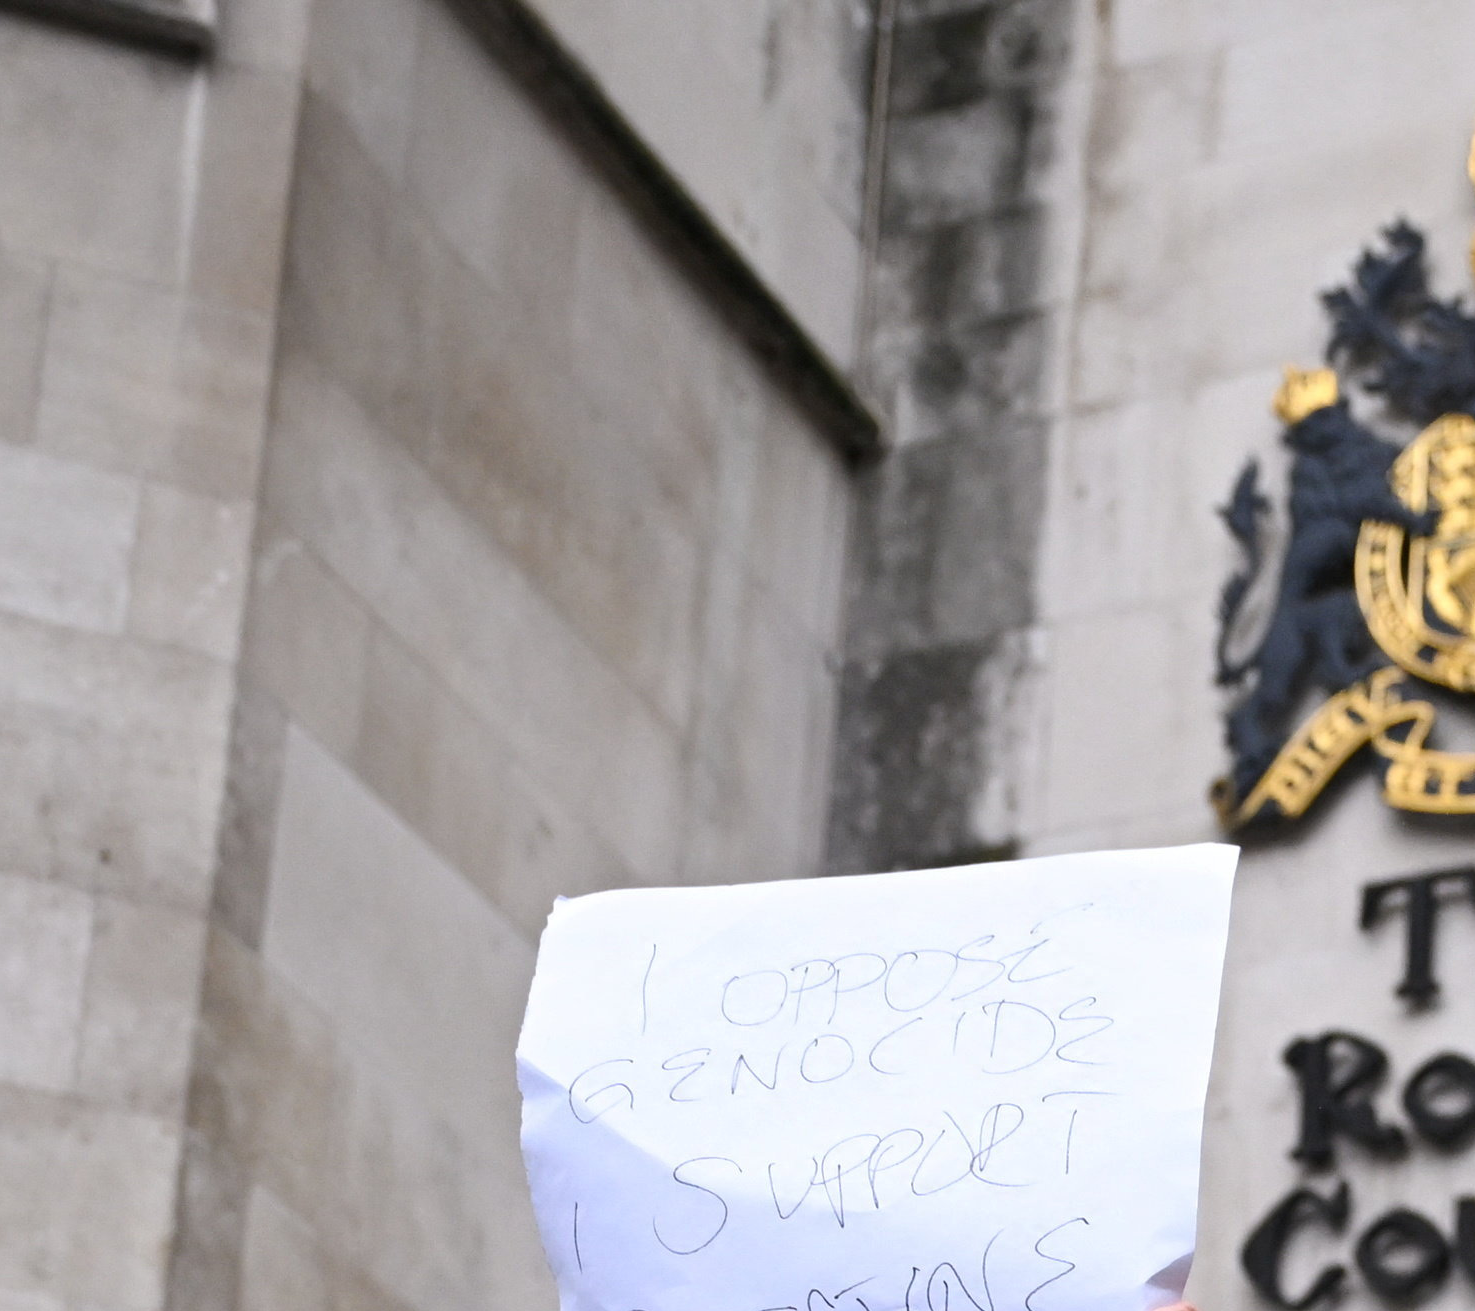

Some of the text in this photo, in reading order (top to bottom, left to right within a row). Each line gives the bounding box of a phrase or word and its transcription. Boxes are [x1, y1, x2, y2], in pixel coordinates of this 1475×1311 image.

[721, 902, 1096, 1026] OPPOSE
[568, 997, 1118, 1124] GENOCIDE
[653, 1090, 1119, 1255] SUPPORT
